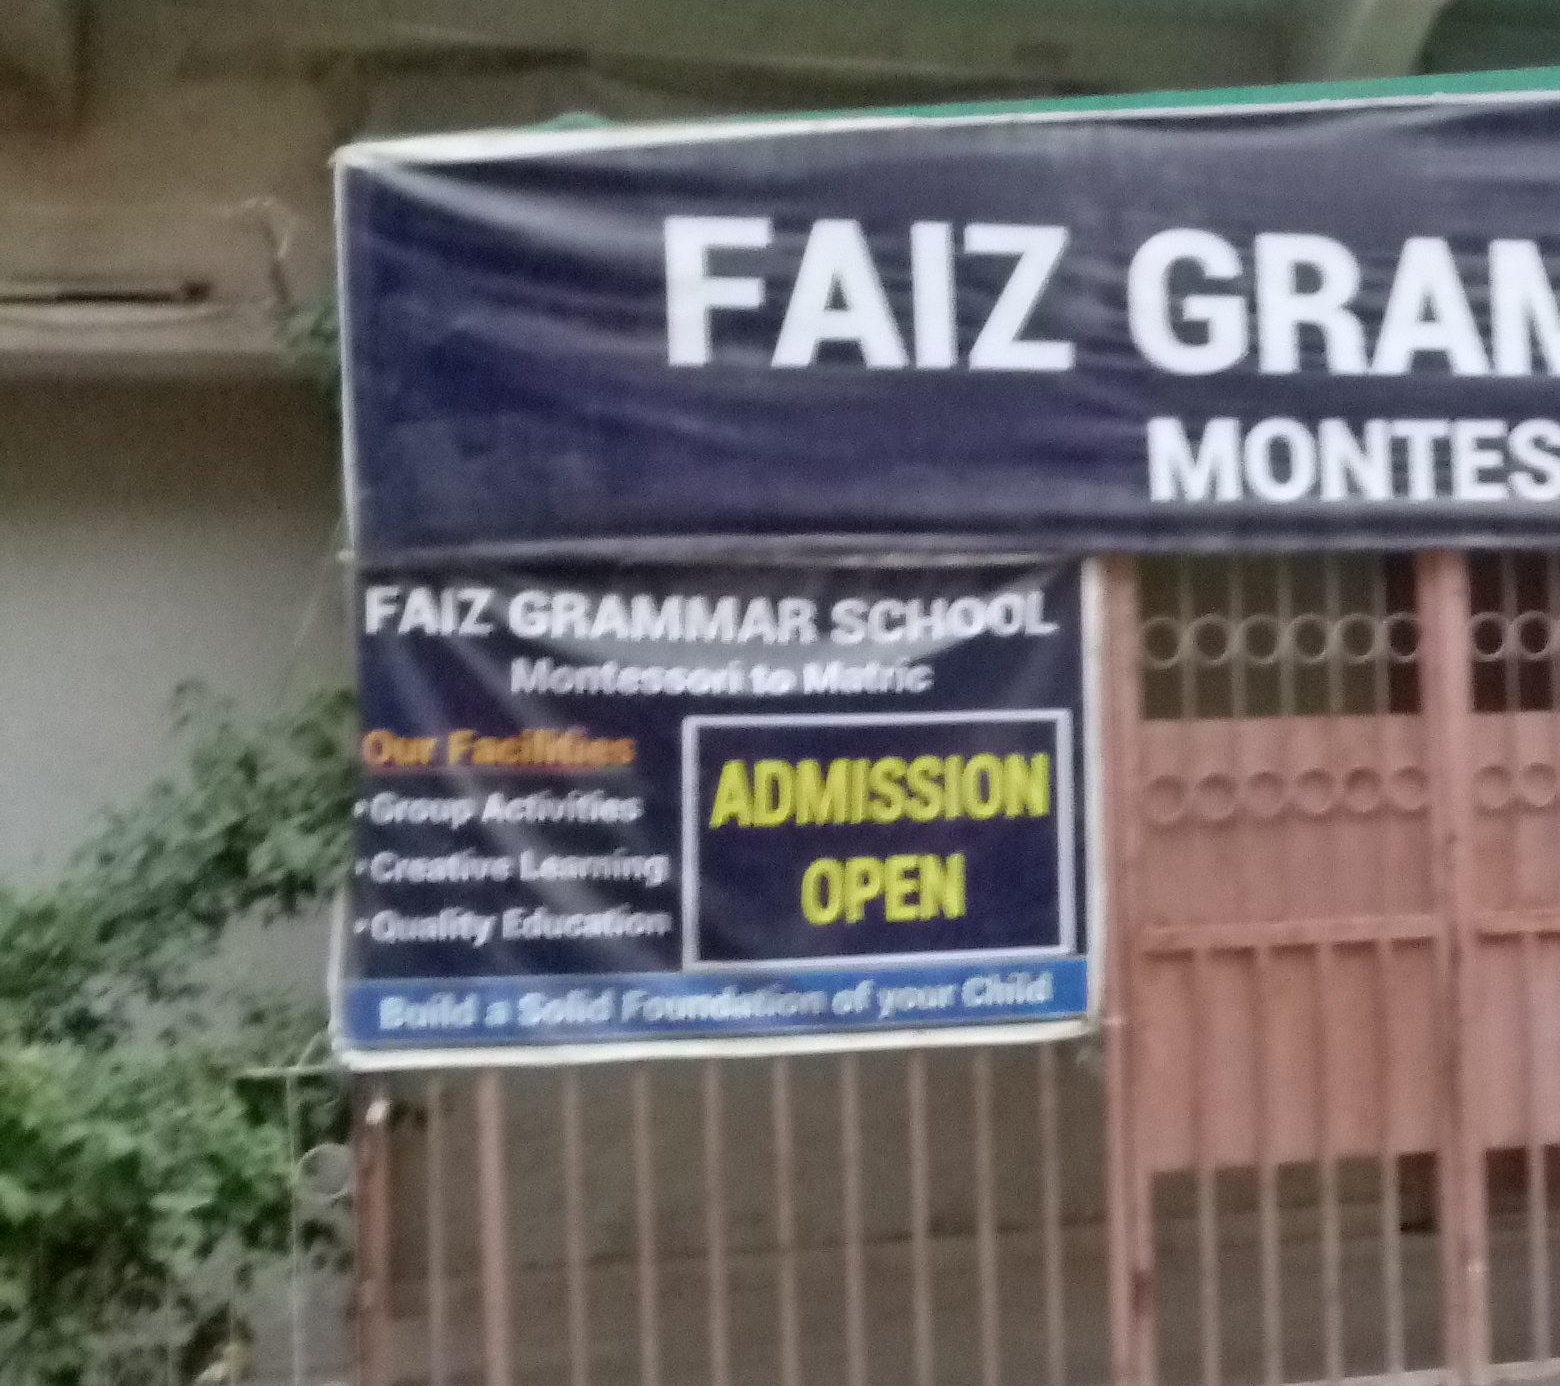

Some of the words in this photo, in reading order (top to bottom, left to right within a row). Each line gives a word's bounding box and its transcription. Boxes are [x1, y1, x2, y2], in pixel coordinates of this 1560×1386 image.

[663, 216, 1076, 371] FAIZ
[365, 586, 494, 637] FAIZ
[509, 590, 818, 645] GRAMMAR
[830, 590, 1060, 644] SCHOOL
[511, 657, 740, 696] Montessori
[749, 662, 797, 695] to
[802, 659, 934, 695] Matric
[362, 729, 437, 766] Our
[448, 728, 637, 765] Facilities
[370, 791, 475, 830] Group
[481, 789, 644, 824] Activities
[709, 752, 1050, 830] ADMISSION
[370, 847, 513, 883] Creative
[519, 847, 670, 888] Learning
[801, 853, 966, 926] OPEN
[370, 906, 497, 949] Quality
[502, 903, 673, 939] Education
[379, 992, 478, 1031] Build
[518, 989, 613, 1025] Solid
[620, 985, 826, 1022] Foundation
[831, 979, 872, 1015] of
[878, 984, 954, 1020] your
[961, 971, 1054, 1010] Child
